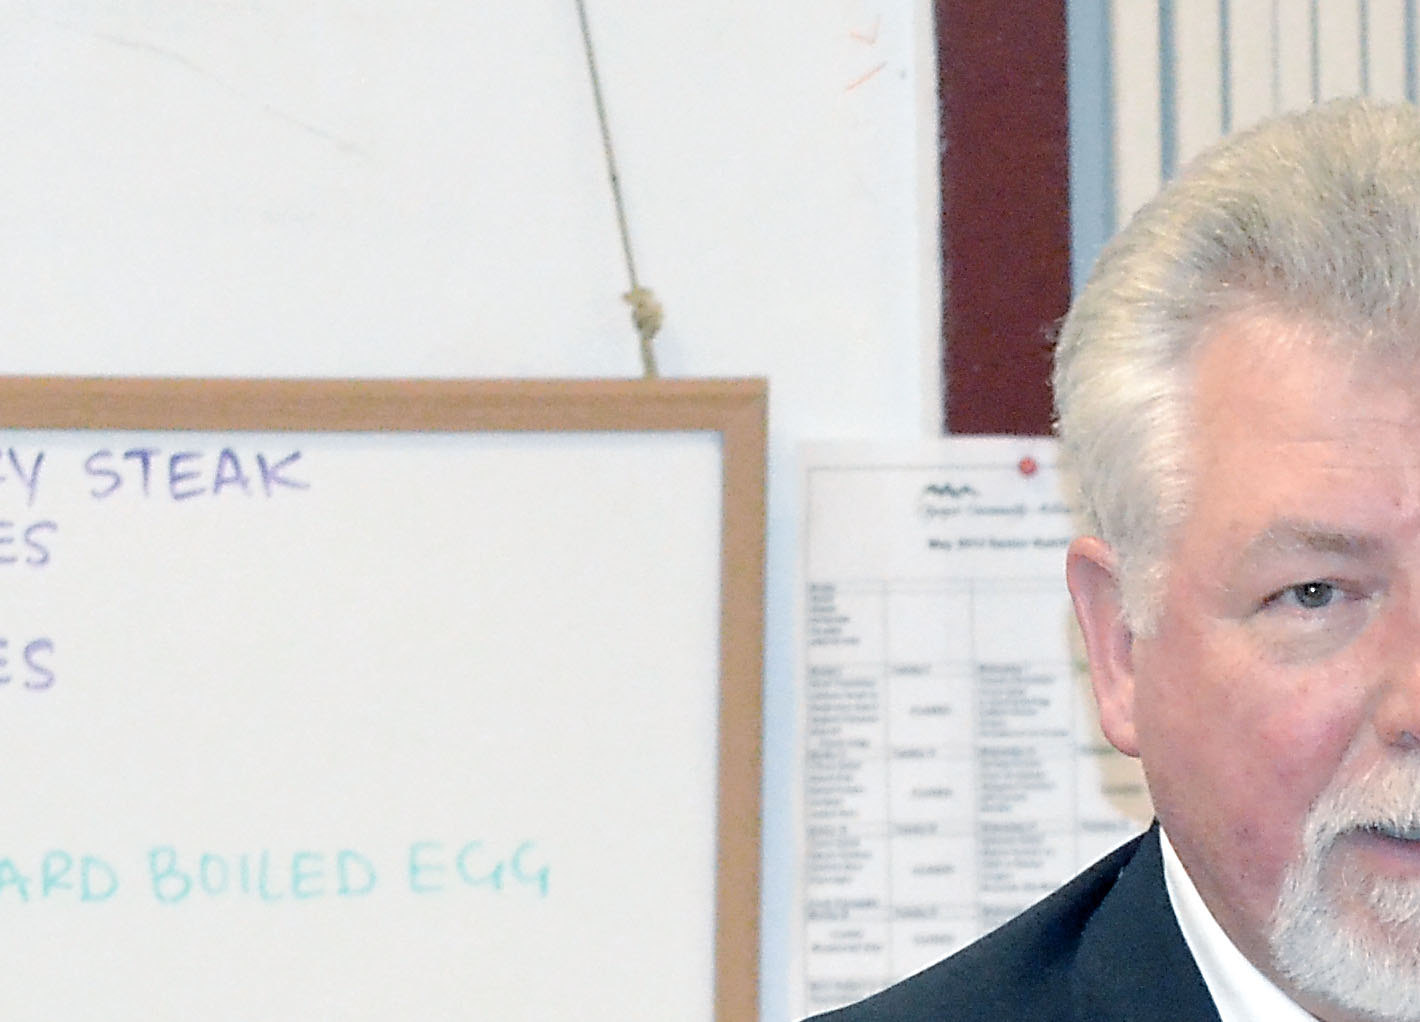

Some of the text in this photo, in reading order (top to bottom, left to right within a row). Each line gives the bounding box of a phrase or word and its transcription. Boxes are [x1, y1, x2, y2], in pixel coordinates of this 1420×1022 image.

[0, 446, 310, 507] Y STEAK
[147, 846, 377, 904] BOILED
[408, 840, 550, 898] EGG
